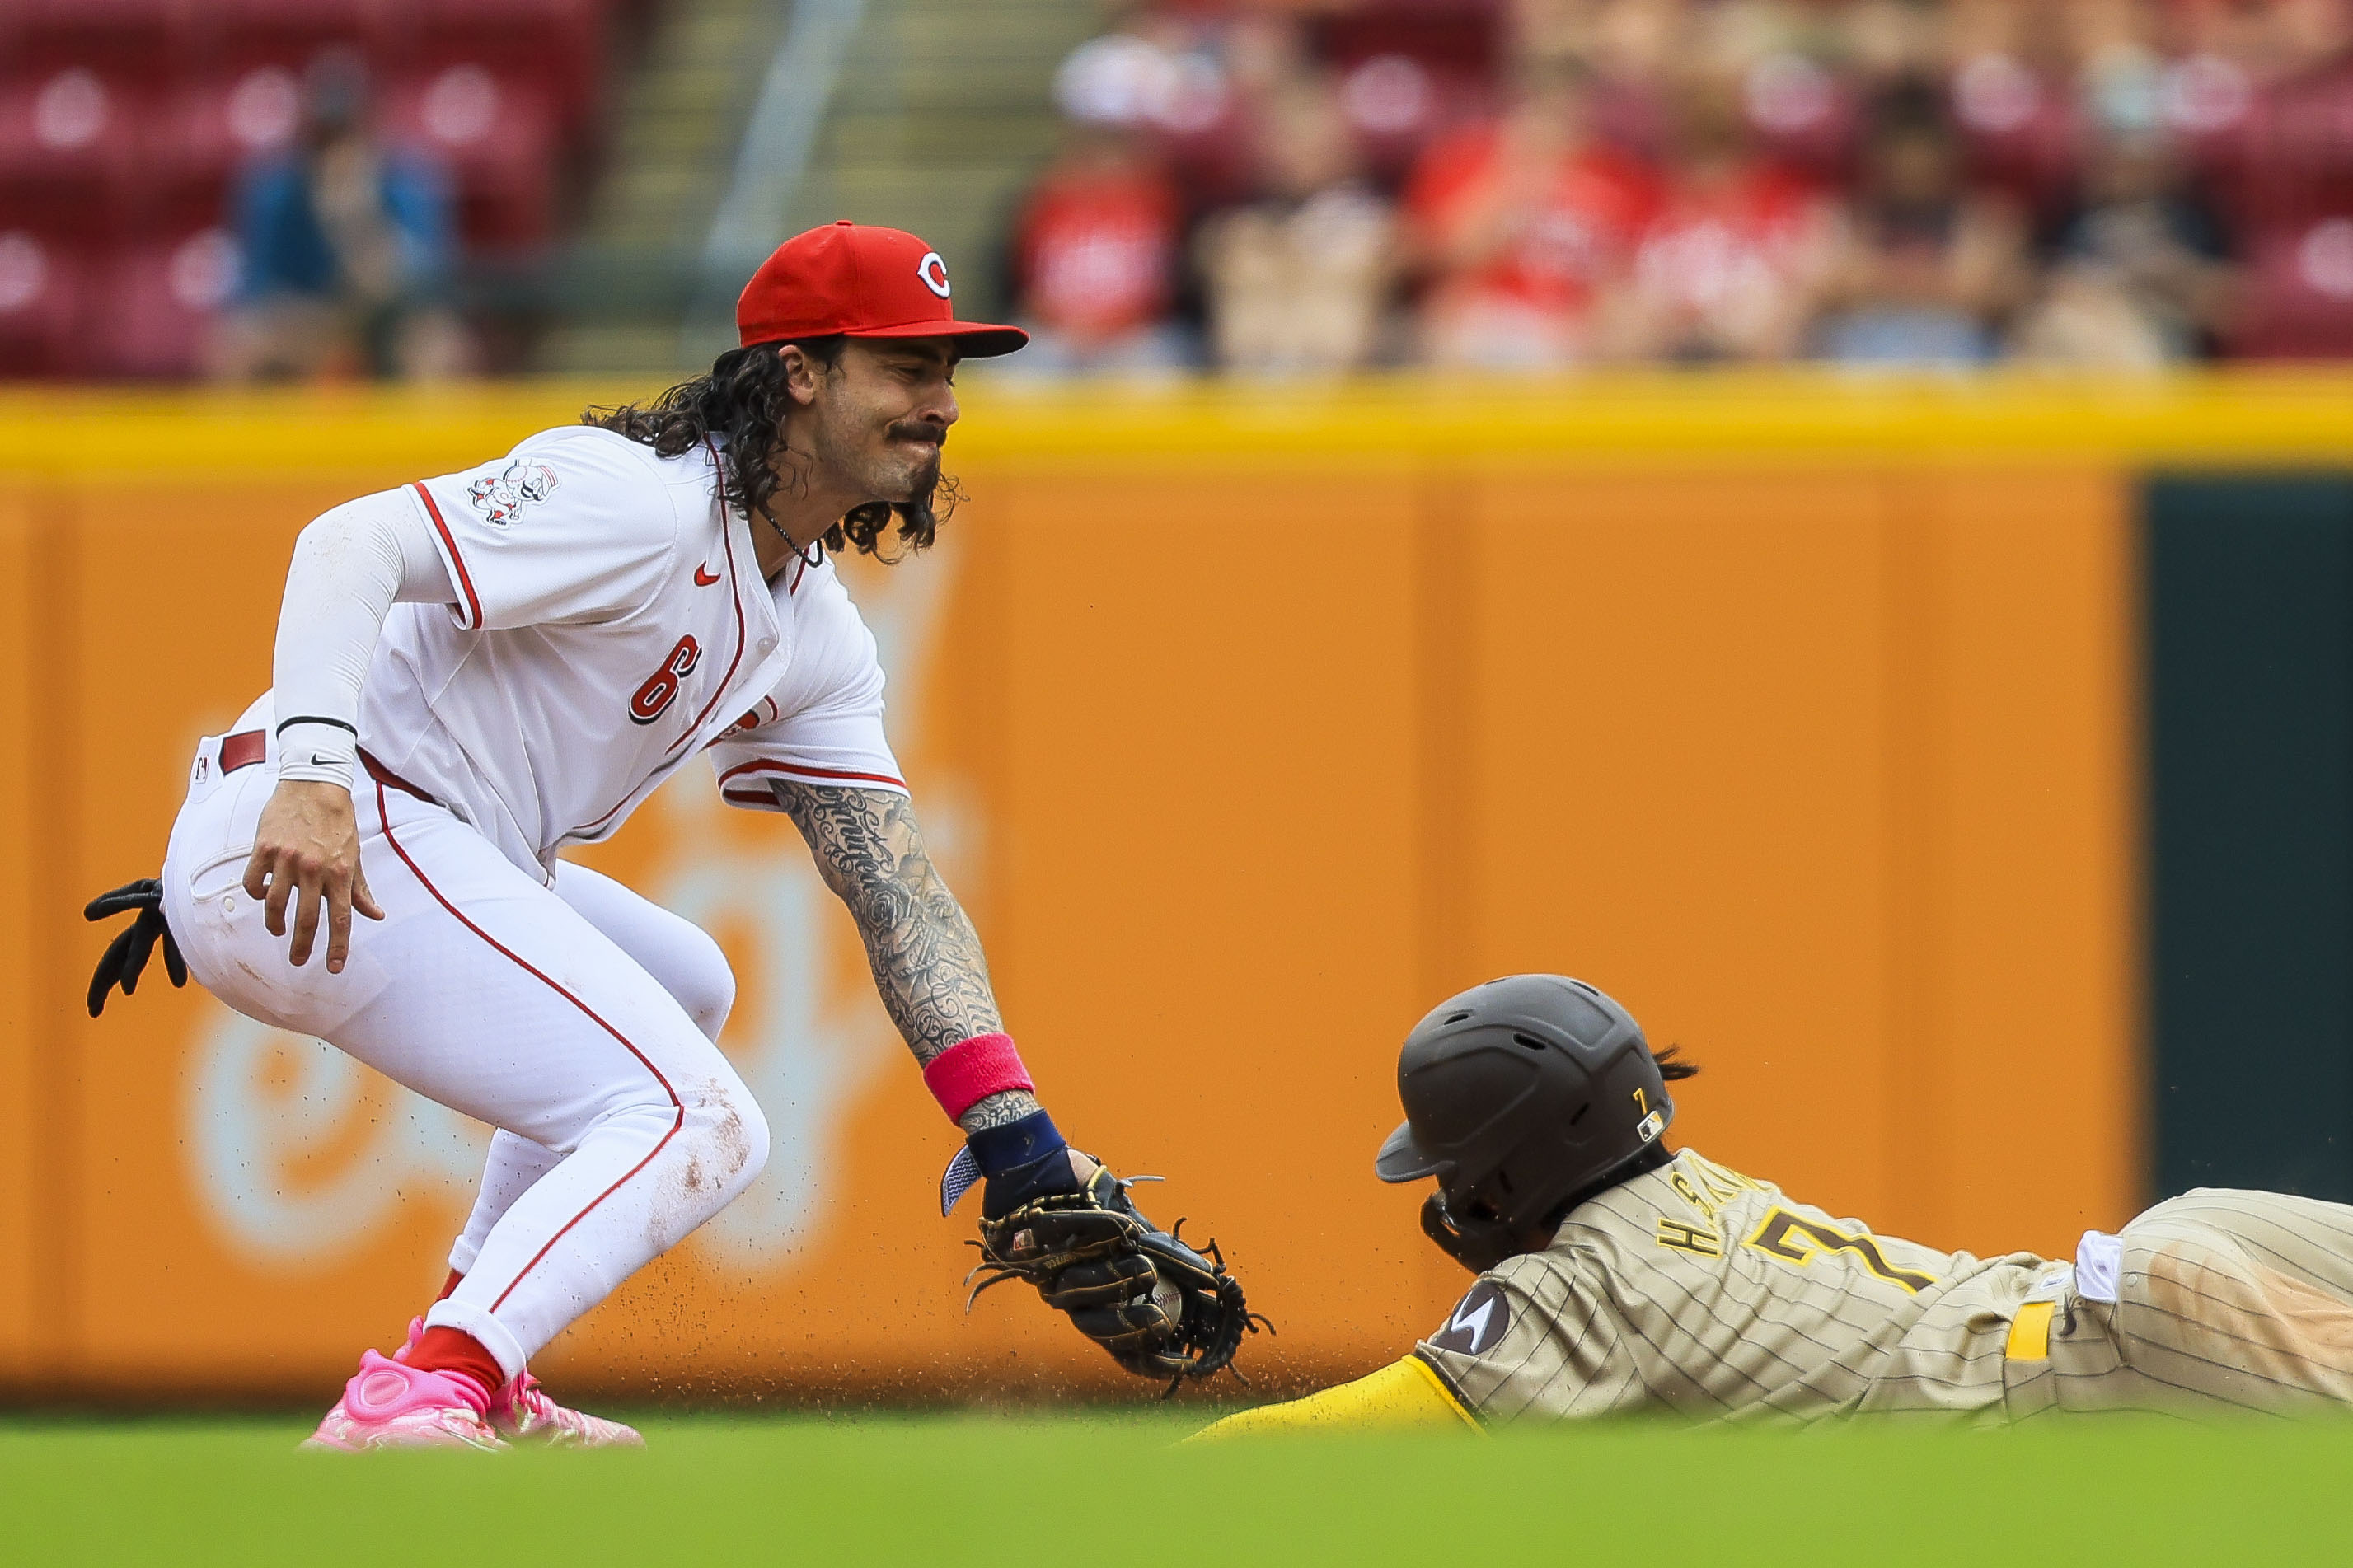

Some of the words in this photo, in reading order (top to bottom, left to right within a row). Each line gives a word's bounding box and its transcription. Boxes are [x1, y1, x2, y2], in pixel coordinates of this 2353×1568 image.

[916, 251, 951, 298] C
[628, 633, 703, 725] 6
[1632, 1087, 1648, 1115] 7
[1739, 1204, 1939, 1296] 7
